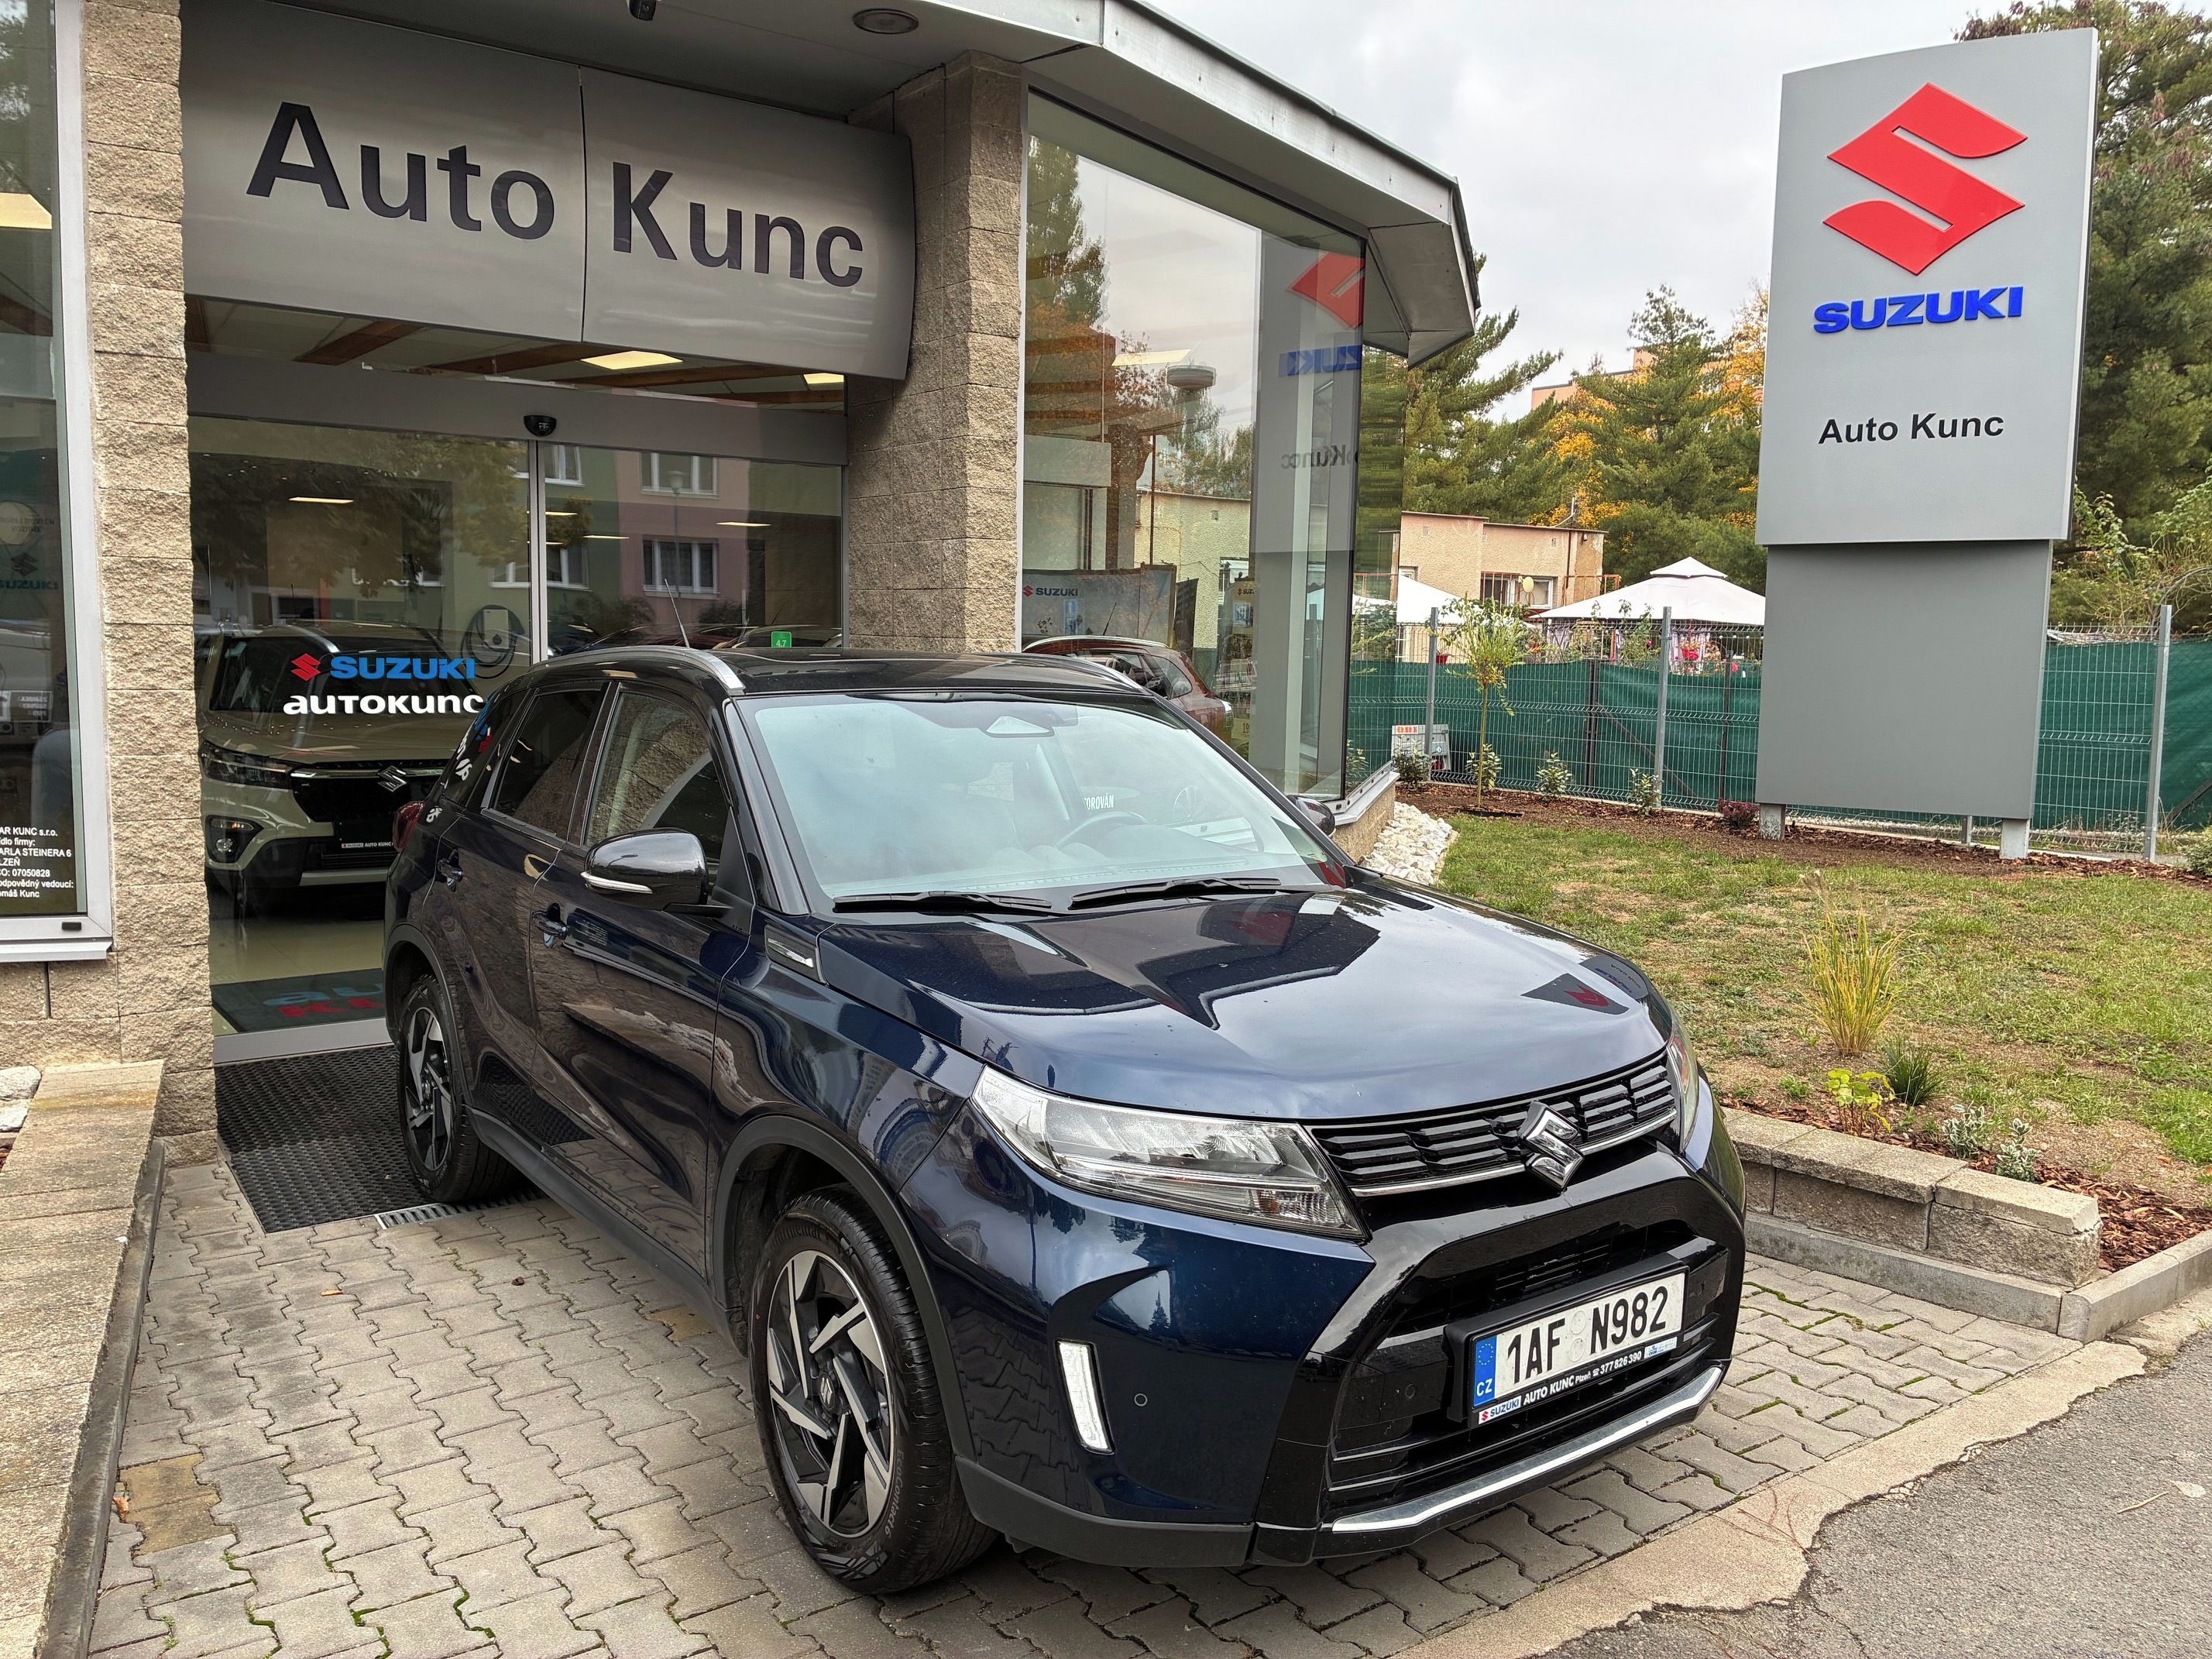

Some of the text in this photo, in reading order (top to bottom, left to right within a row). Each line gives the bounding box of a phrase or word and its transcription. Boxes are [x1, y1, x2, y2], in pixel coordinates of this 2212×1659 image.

[246, 101, 863, 287] Auto Kunc
[1813, 286, 2024, 334] SUZUKI
[1819, 413, 2004, 445] Auto Kunc
[1036, 587, 1078, 596] SUZUKI
[330, 656, 476, 680] SUZUKI
[12, 827, 37, 836] KUNC
[0, 837, 36, 847] dlo firmy:
[22, 848, 65, 857] STEINERA
[12, 869, 50, 878] 07050828
[41, 880, 74, 888] vedoucí:
[1507, 1286, 1668, 1384] 1AF N982
[1477, 1378, 1492, 1396] CZ
[1490, 1398, 1520, 1417] SUZUKI
[1523, 1387, 1547, 1406] AUTO
[1550, 1375, 1575, 1394] KUNC
